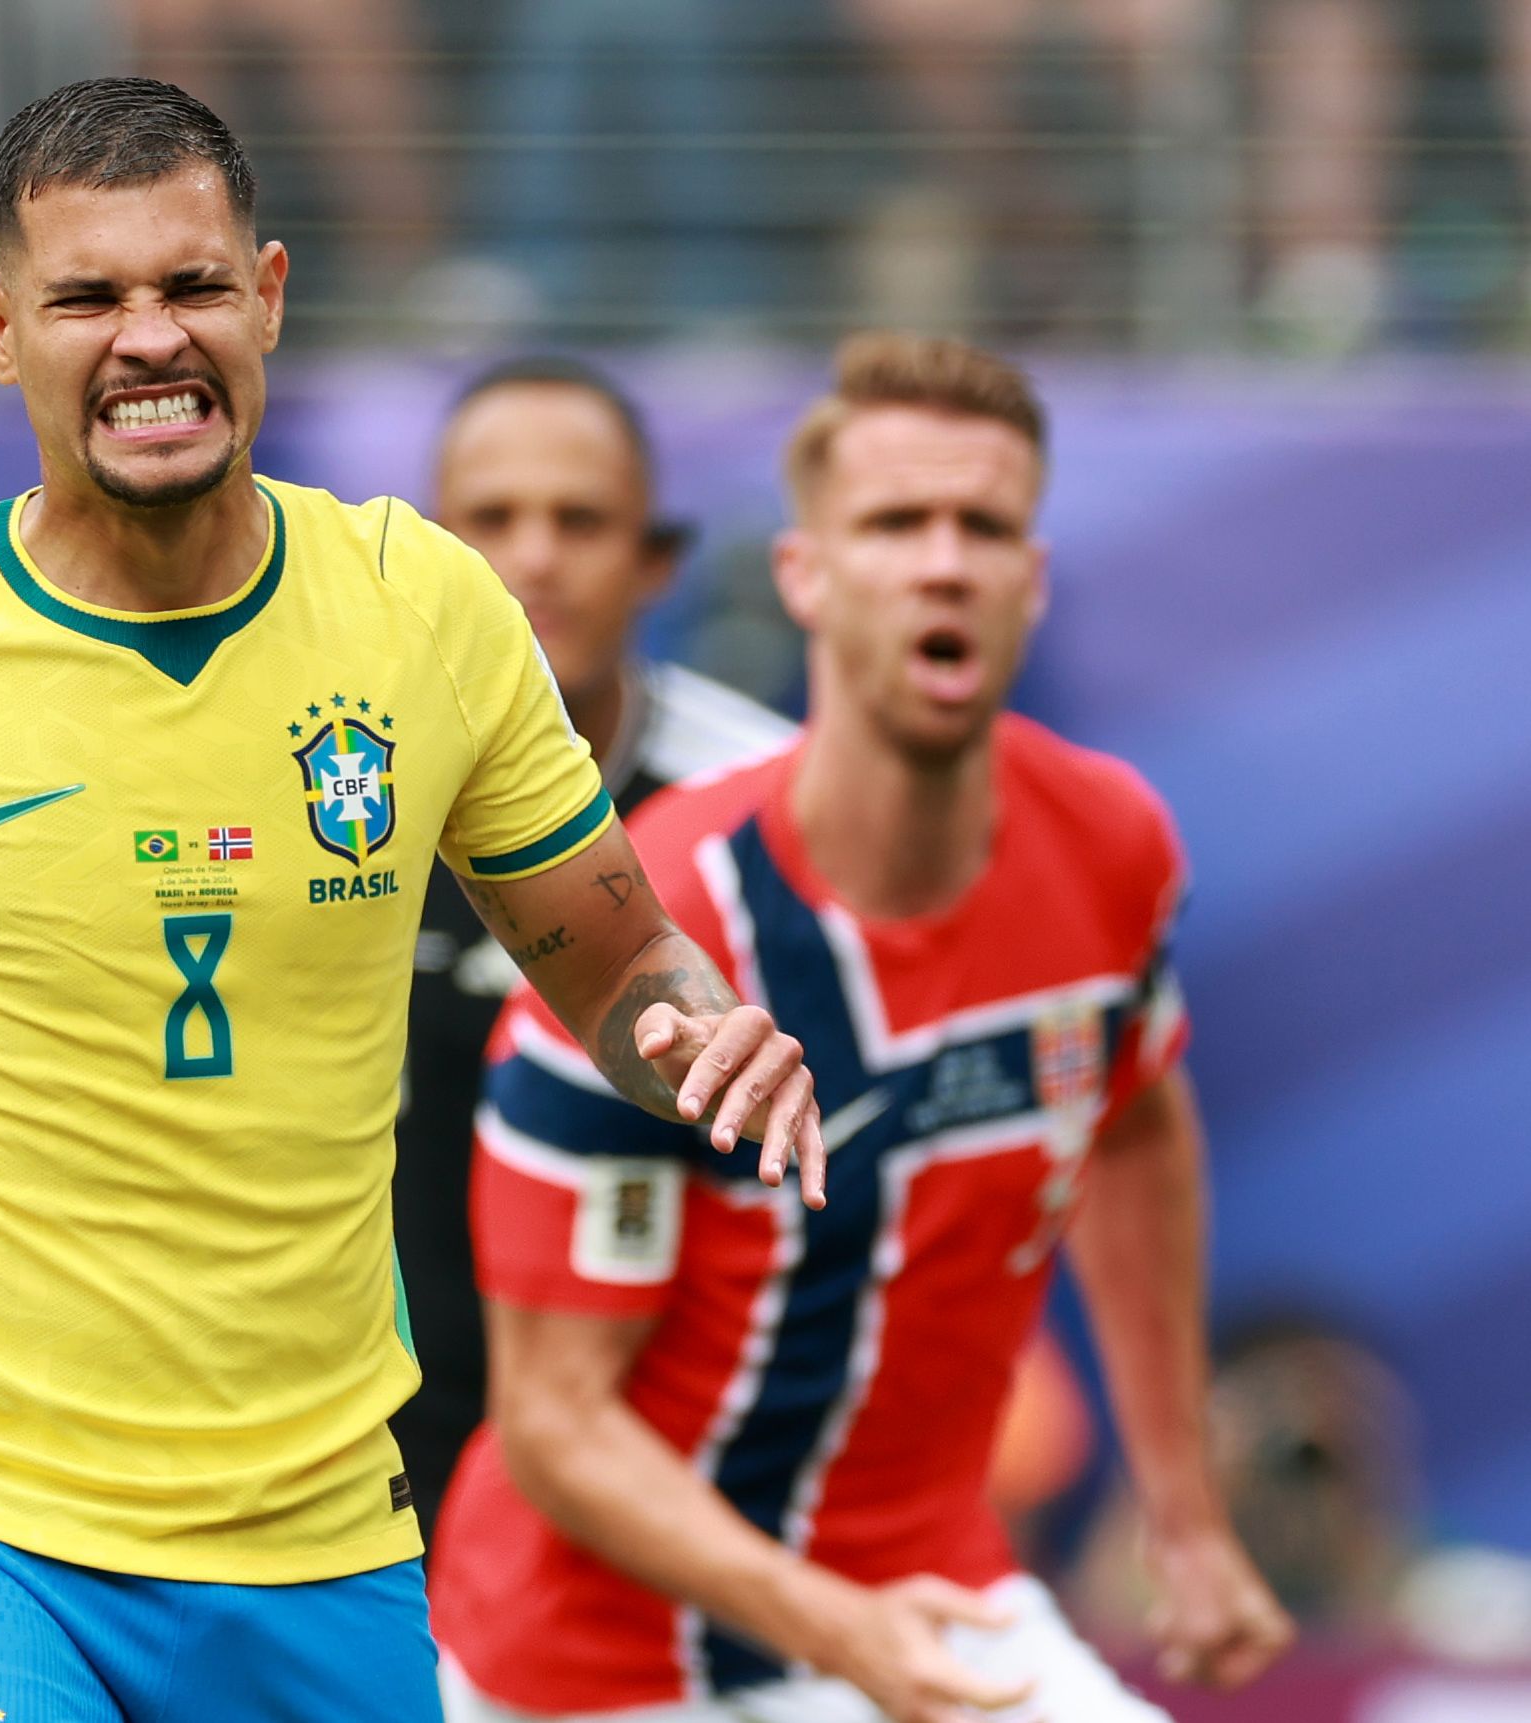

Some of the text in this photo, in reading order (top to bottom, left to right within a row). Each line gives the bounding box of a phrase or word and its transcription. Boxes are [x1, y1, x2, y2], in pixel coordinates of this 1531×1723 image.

[333, 778, 368, 796] CBF
[155, 889, 183, 898] BRASIL
[199, 888, 238, 897] NORUEGA
[309, 869, 399, 904] BRASIL
[163, 912, 232, 1079] 8
